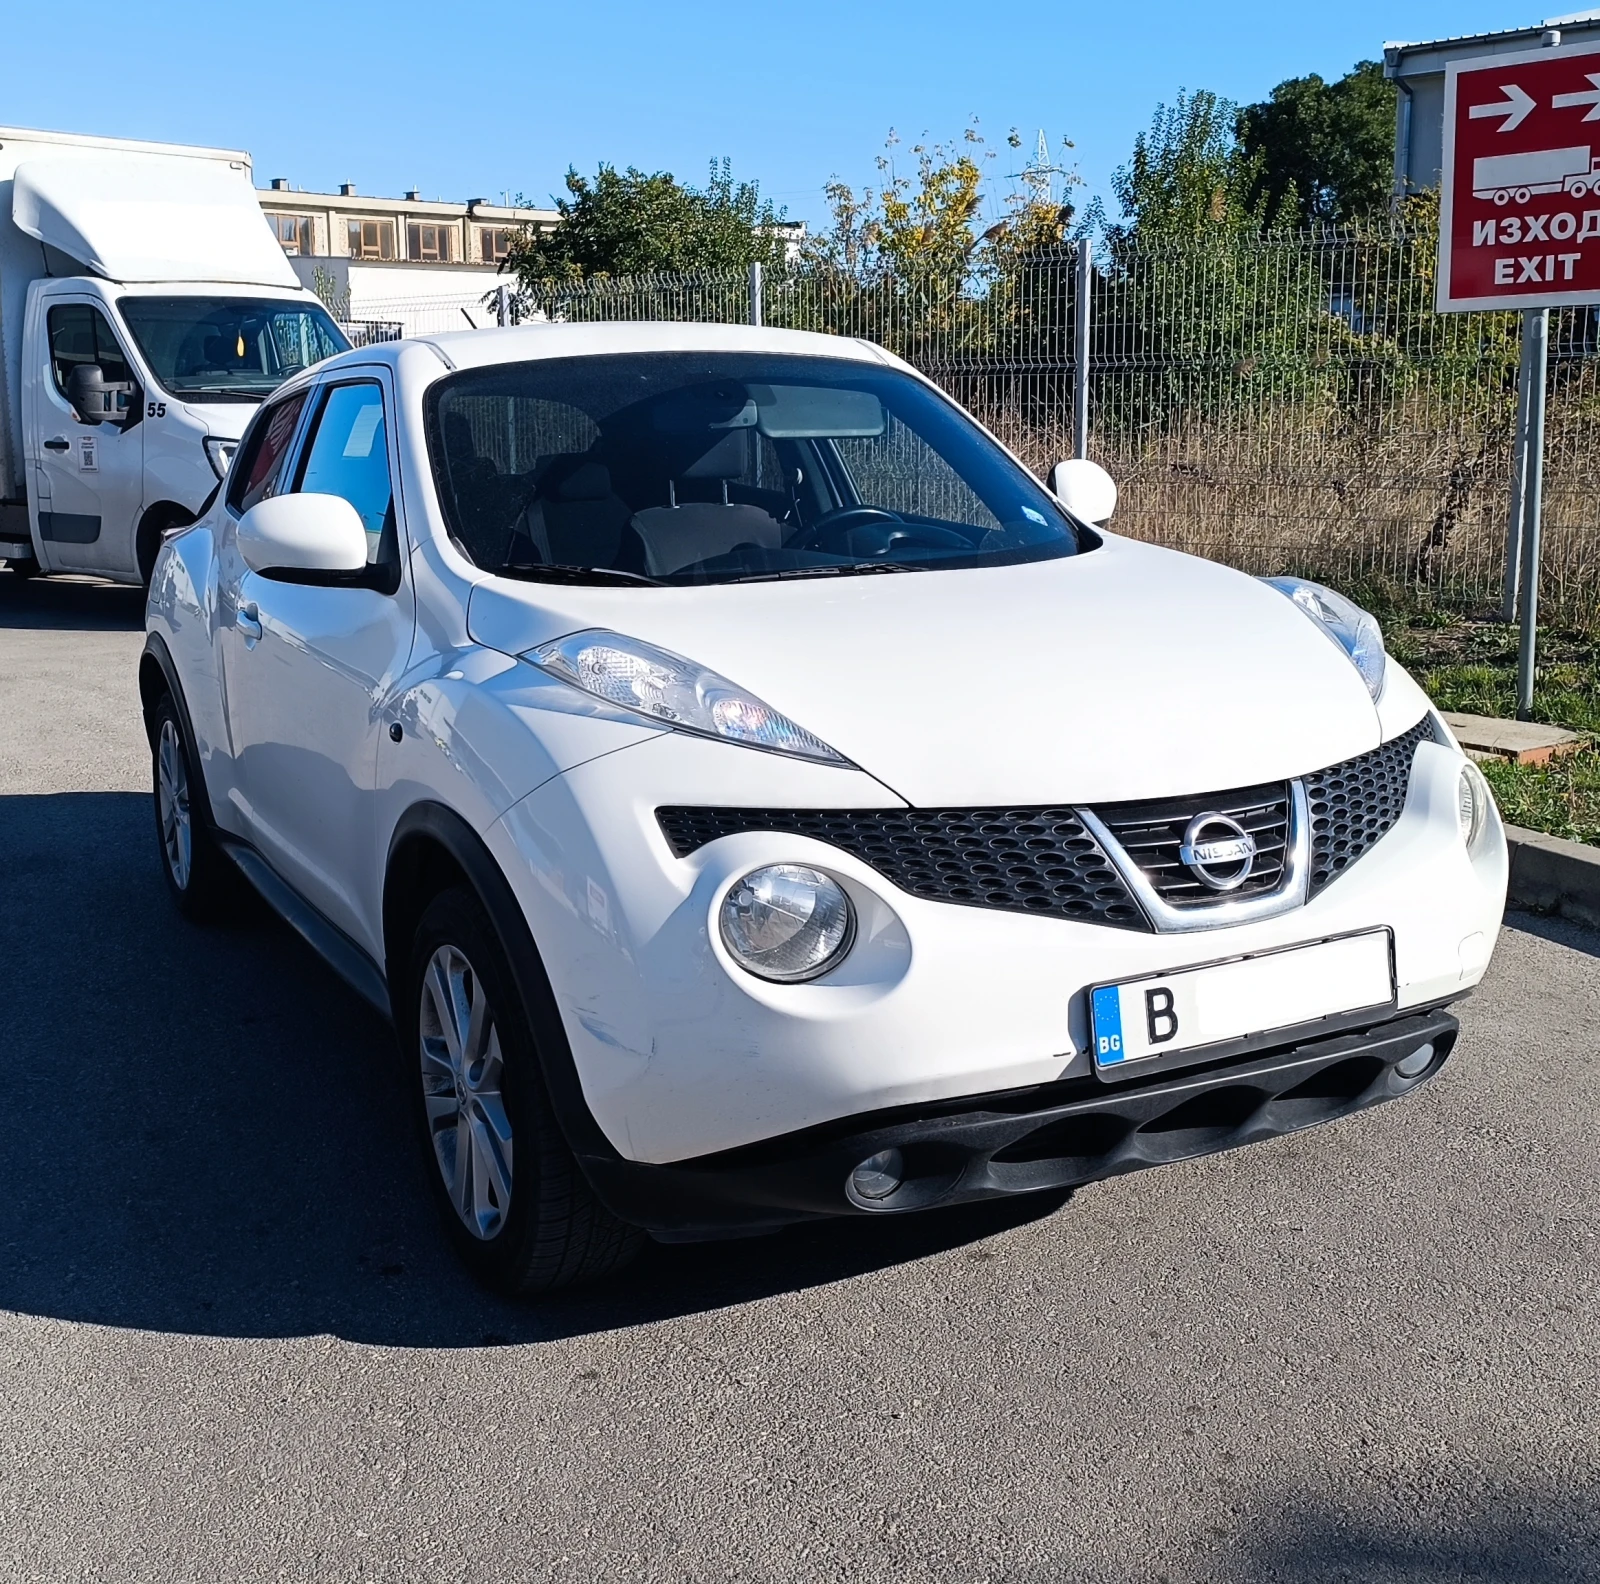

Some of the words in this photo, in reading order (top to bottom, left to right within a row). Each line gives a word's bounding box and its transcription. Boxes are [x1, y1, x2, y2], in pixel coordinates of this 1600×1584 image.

[1472, 209, 1600, 247] ИЗХОД
[1494, 252, 1582, 285] EXIT
[147, 402, 167, 418] 55
[1144, 986, 1179, 1045] B
[1099, 1034, 1121, 1054] BG
